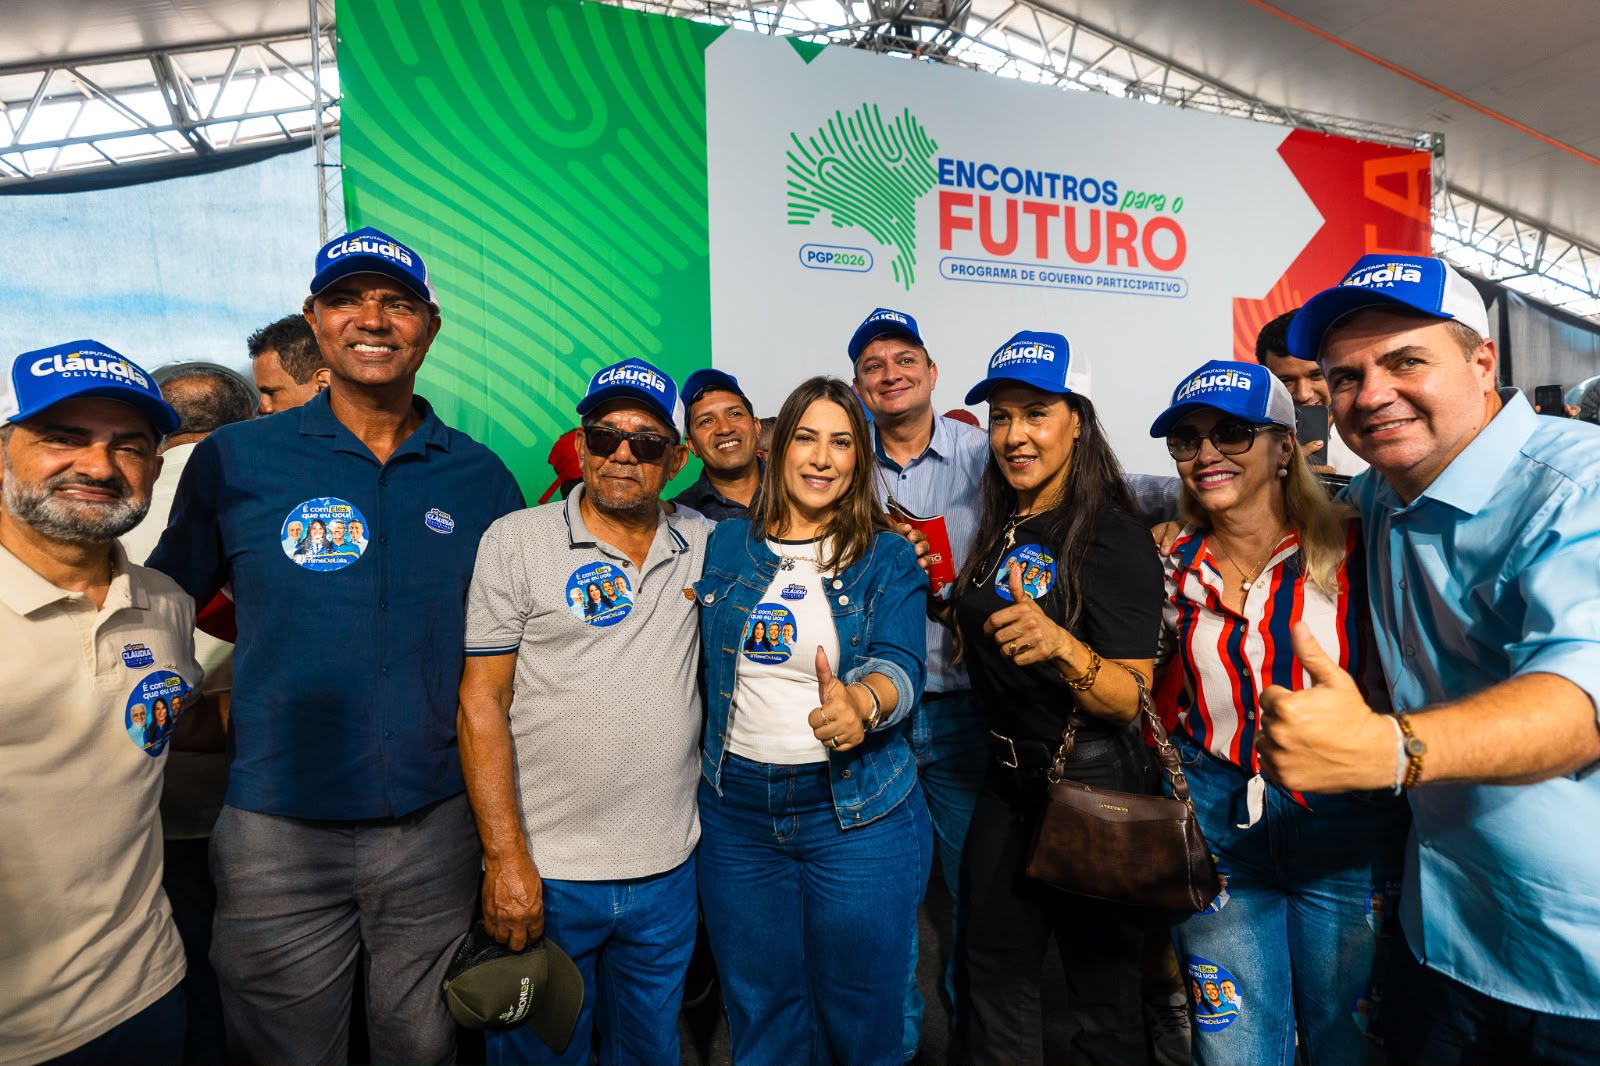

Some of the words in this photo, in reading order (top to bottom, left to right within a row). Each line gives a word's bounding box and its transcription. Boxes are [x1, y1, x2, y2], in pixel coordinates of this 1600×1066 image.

[938, 157, 1118, 206] ENCONTROS
[1120, 188, 1167, 214] para
[1171, 196, 1184, 214] o
[938, 190, 1188, 272] FUTURO
[327, 238, 412, 268] Cláudia
[807, 250, 866, 267] PGP2026
[951, 263, 1018, 281] PROGRAMA
[1021, 270, 1036, 282] DE
[1038, 271, 1093, 286] GOVERNO
[1096, 276, 1181, 293] PARTICIPATIVO
[79, 350, 117, 360] DEPUTADA
[999, 358, 1038, 369] OLIVEIRA
[30, 353, 149, 390] Cláudia
[62, 371, 132, 386] OLIVEIRA
[597, 366, 666, 393] Cláudia
[1186, 386, 1232, 399] OLIVEIRA
